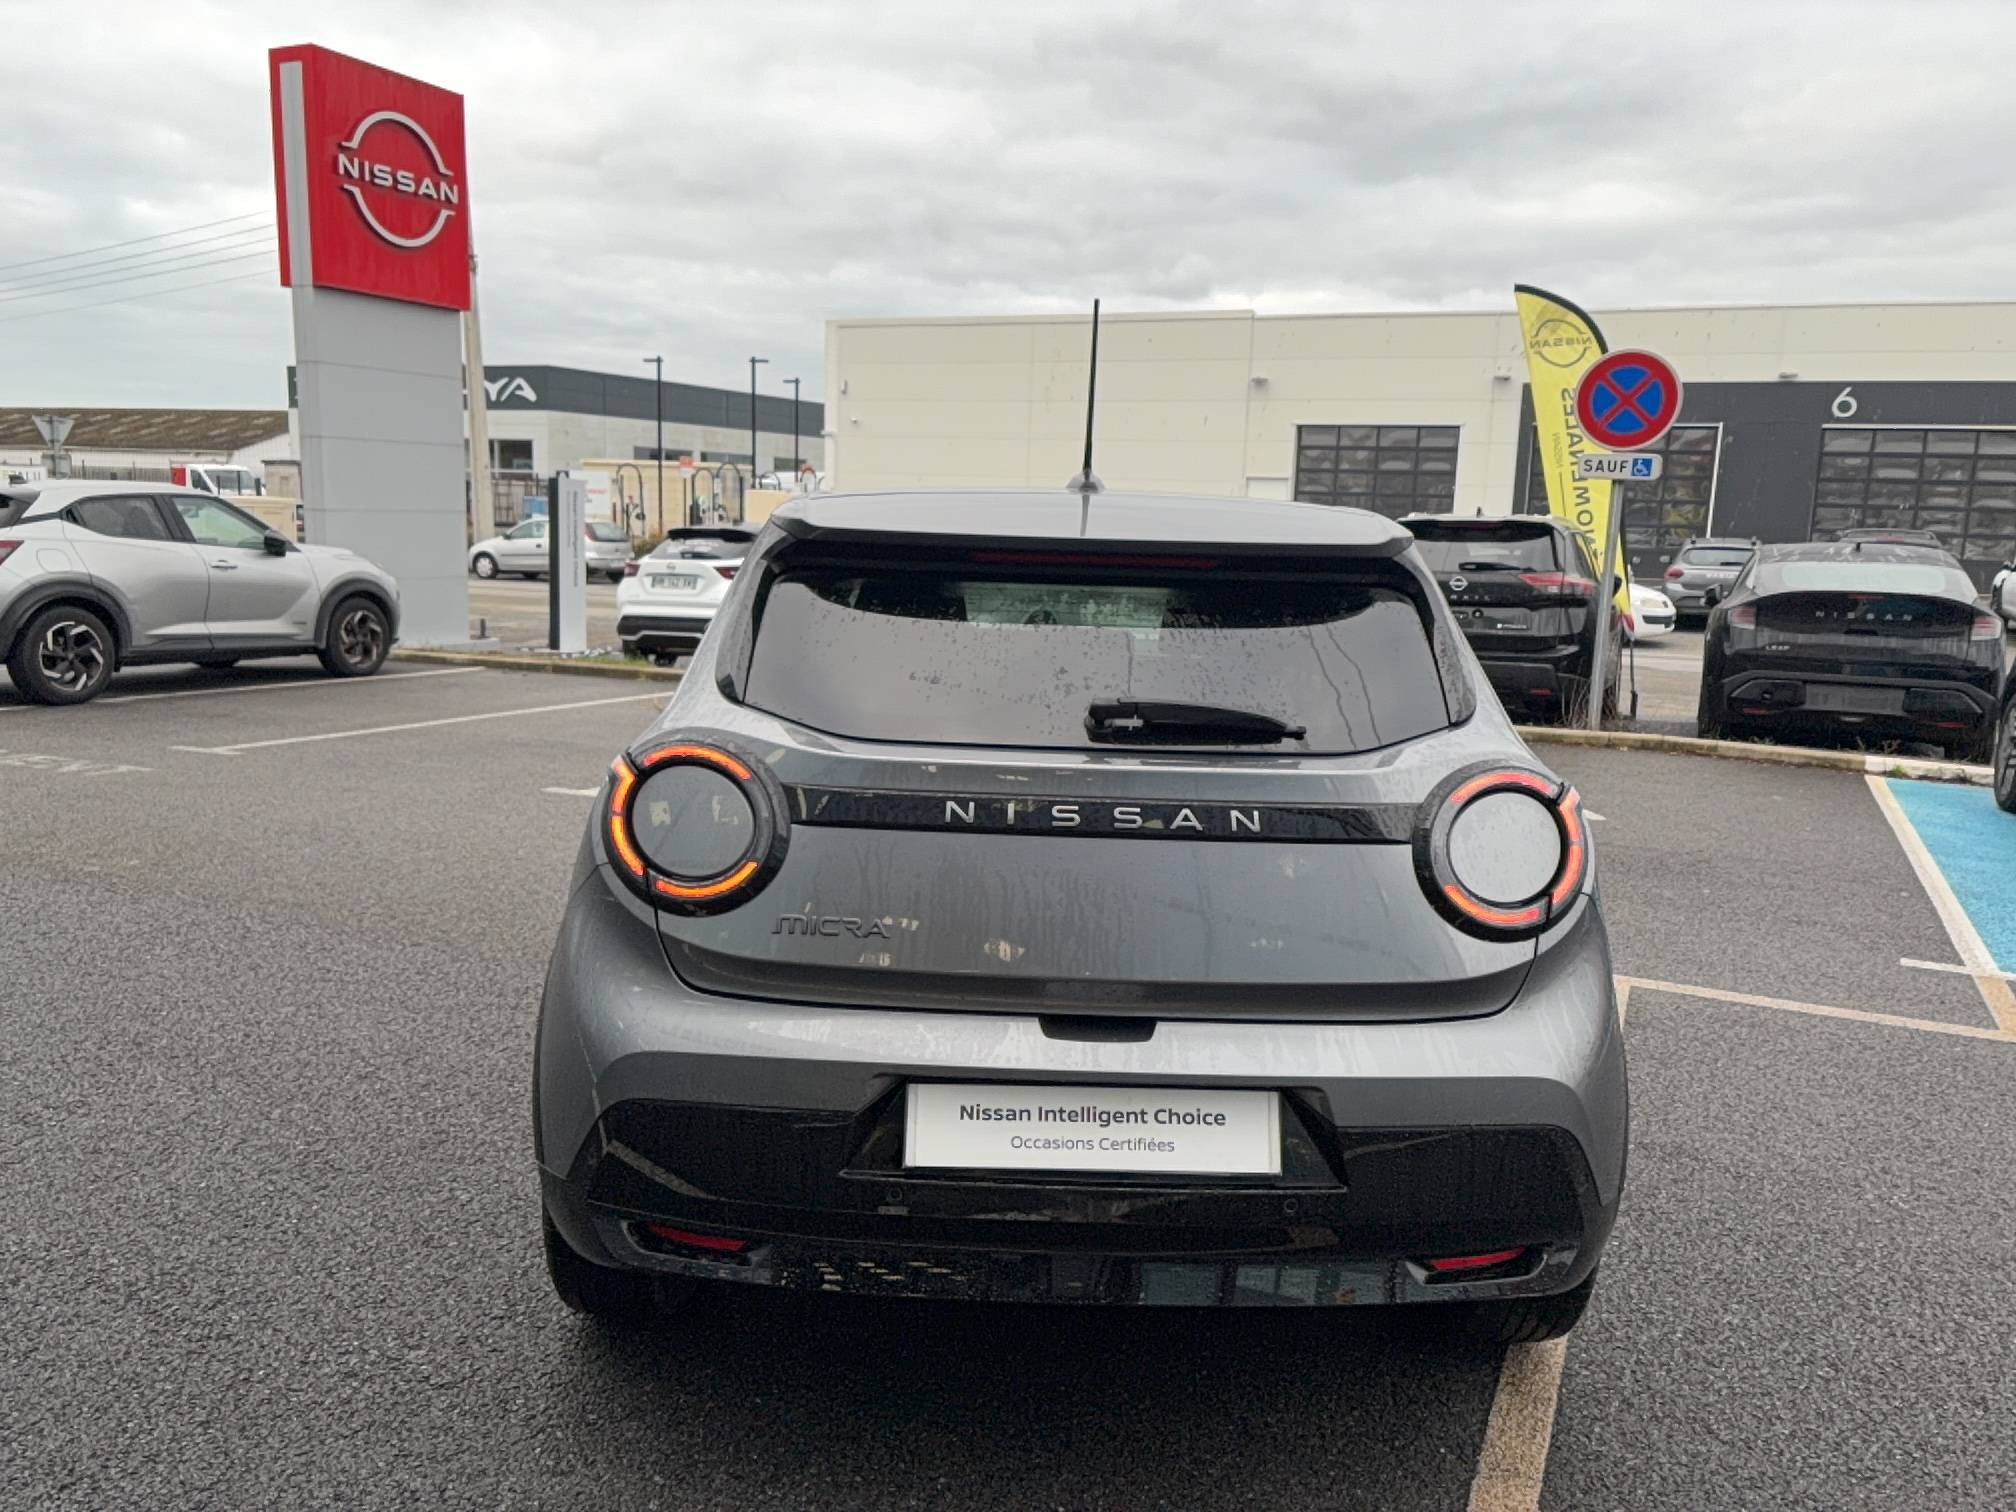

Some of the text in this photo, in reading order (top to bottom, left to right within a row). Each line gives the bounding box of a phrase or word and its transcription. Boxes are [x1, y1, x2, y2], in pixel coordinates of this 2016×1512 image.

[338, 153, 459, 205] NISSAN
[1831, 386, 1858, 418] 6
[1583, 459, 1629, 473] SAUF
[1815, 610, 1914, 622] NISSAN
[944, 800, 1262, 833] NISSAN
[771, 912, 891, 939] MICRA
[959, 1103, 1227, 1127] Nissan Intelligent Choice
[1010, 1135, 1176, 1153] Occasions Certifiées
